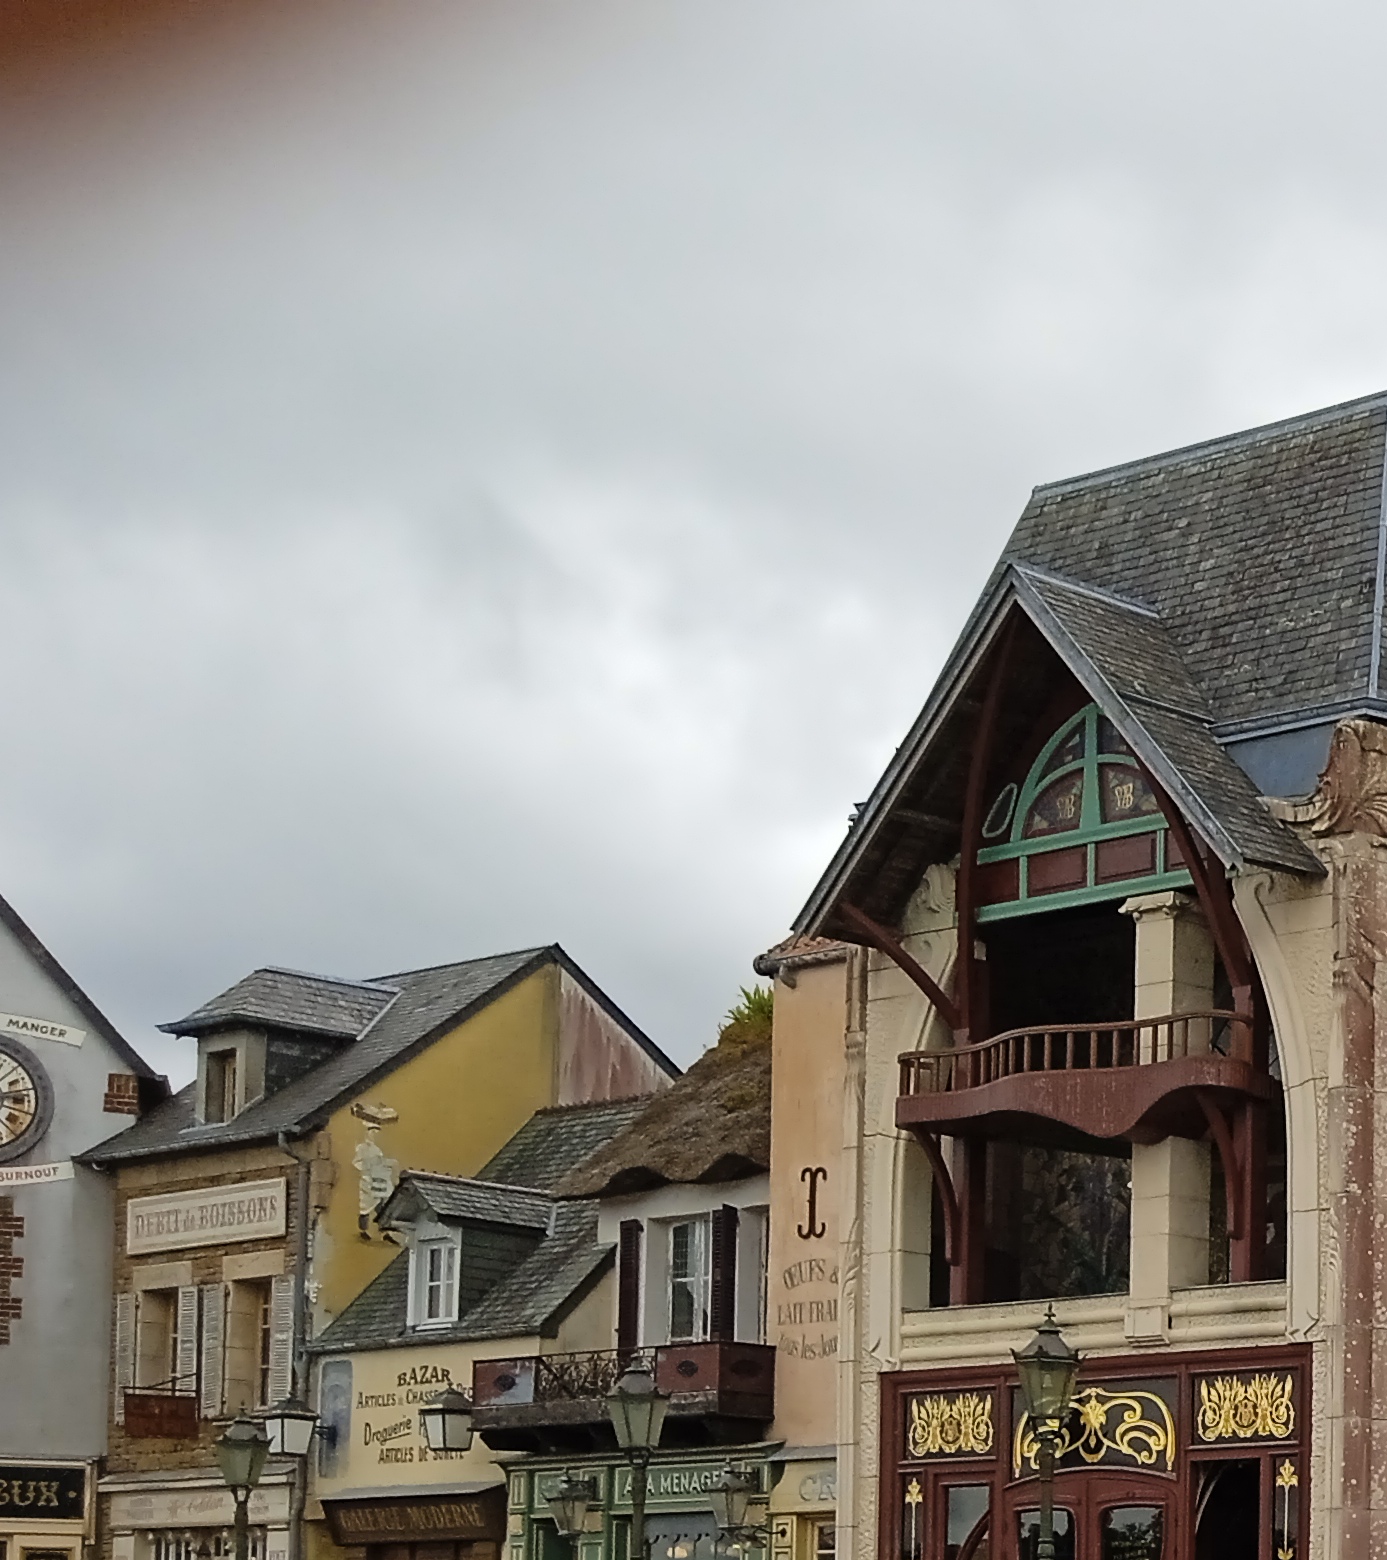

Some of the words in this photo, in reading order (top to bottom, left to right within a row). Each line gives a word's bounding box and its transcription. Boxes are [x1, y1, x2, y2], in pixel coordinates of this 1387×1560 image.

[7, 1018, 68, 1039] MANGER
[199, 1195, 278, 1231] BOISSONS
[809, 1299, 838, 1324] FRAI
[397, 1365, 451, 1388] BAZAR
